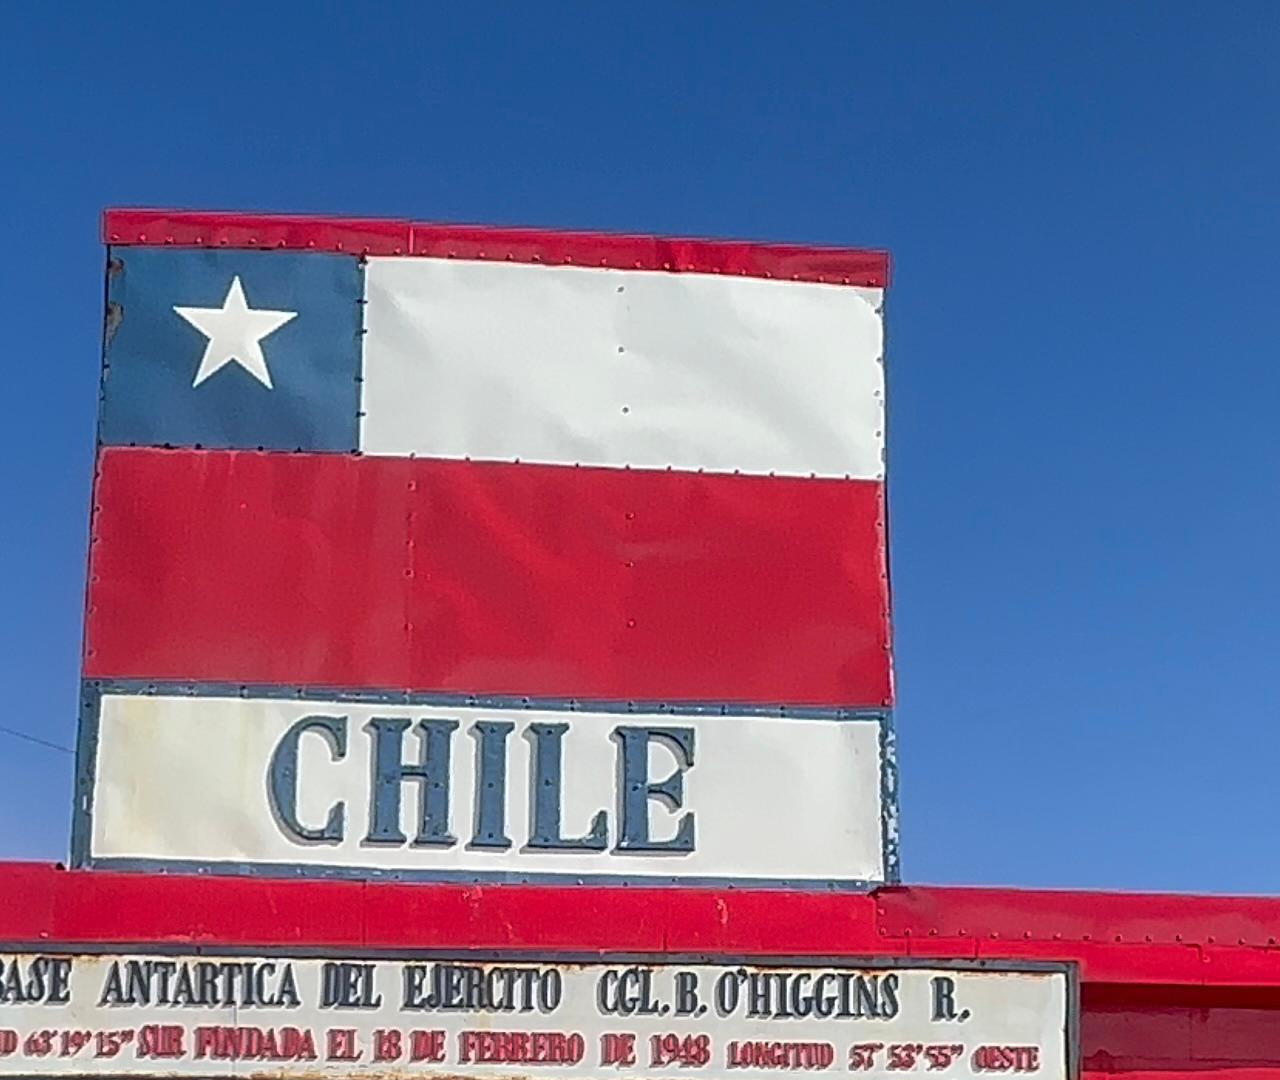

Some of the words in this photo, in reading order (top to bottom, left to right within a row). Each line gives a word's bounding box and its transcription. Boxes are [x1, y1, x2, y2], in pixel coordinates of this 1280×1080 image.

[267, 715, 696, 857] CHILE
[98, 960, 301, 1010] ANTARTICA
[319, 962, 381, 1010] DEL
[400, 962, 562, 1013] EJERCITO
[715, 968, 900, 1022] O'HIGGINS
[931, 976, 970, 1022] R.
[136, 1024, 187, 1059] SUR
[193, 1025, 318, 1062] FUNDADA
[326, 1029, 363, 1062] EL
[371, 1029, 402, 1063] 18
[409, 1030, 446, 1063] DE
[458, 1030, 586, 1066] FEBRERO
[600, 1033, 636, 1067] DE
[649, 1032, 711, 1068] 1948
[727, 1041, 835, 1070] LONGITUD
[971, 1045, 1041, 1073] OESTE
